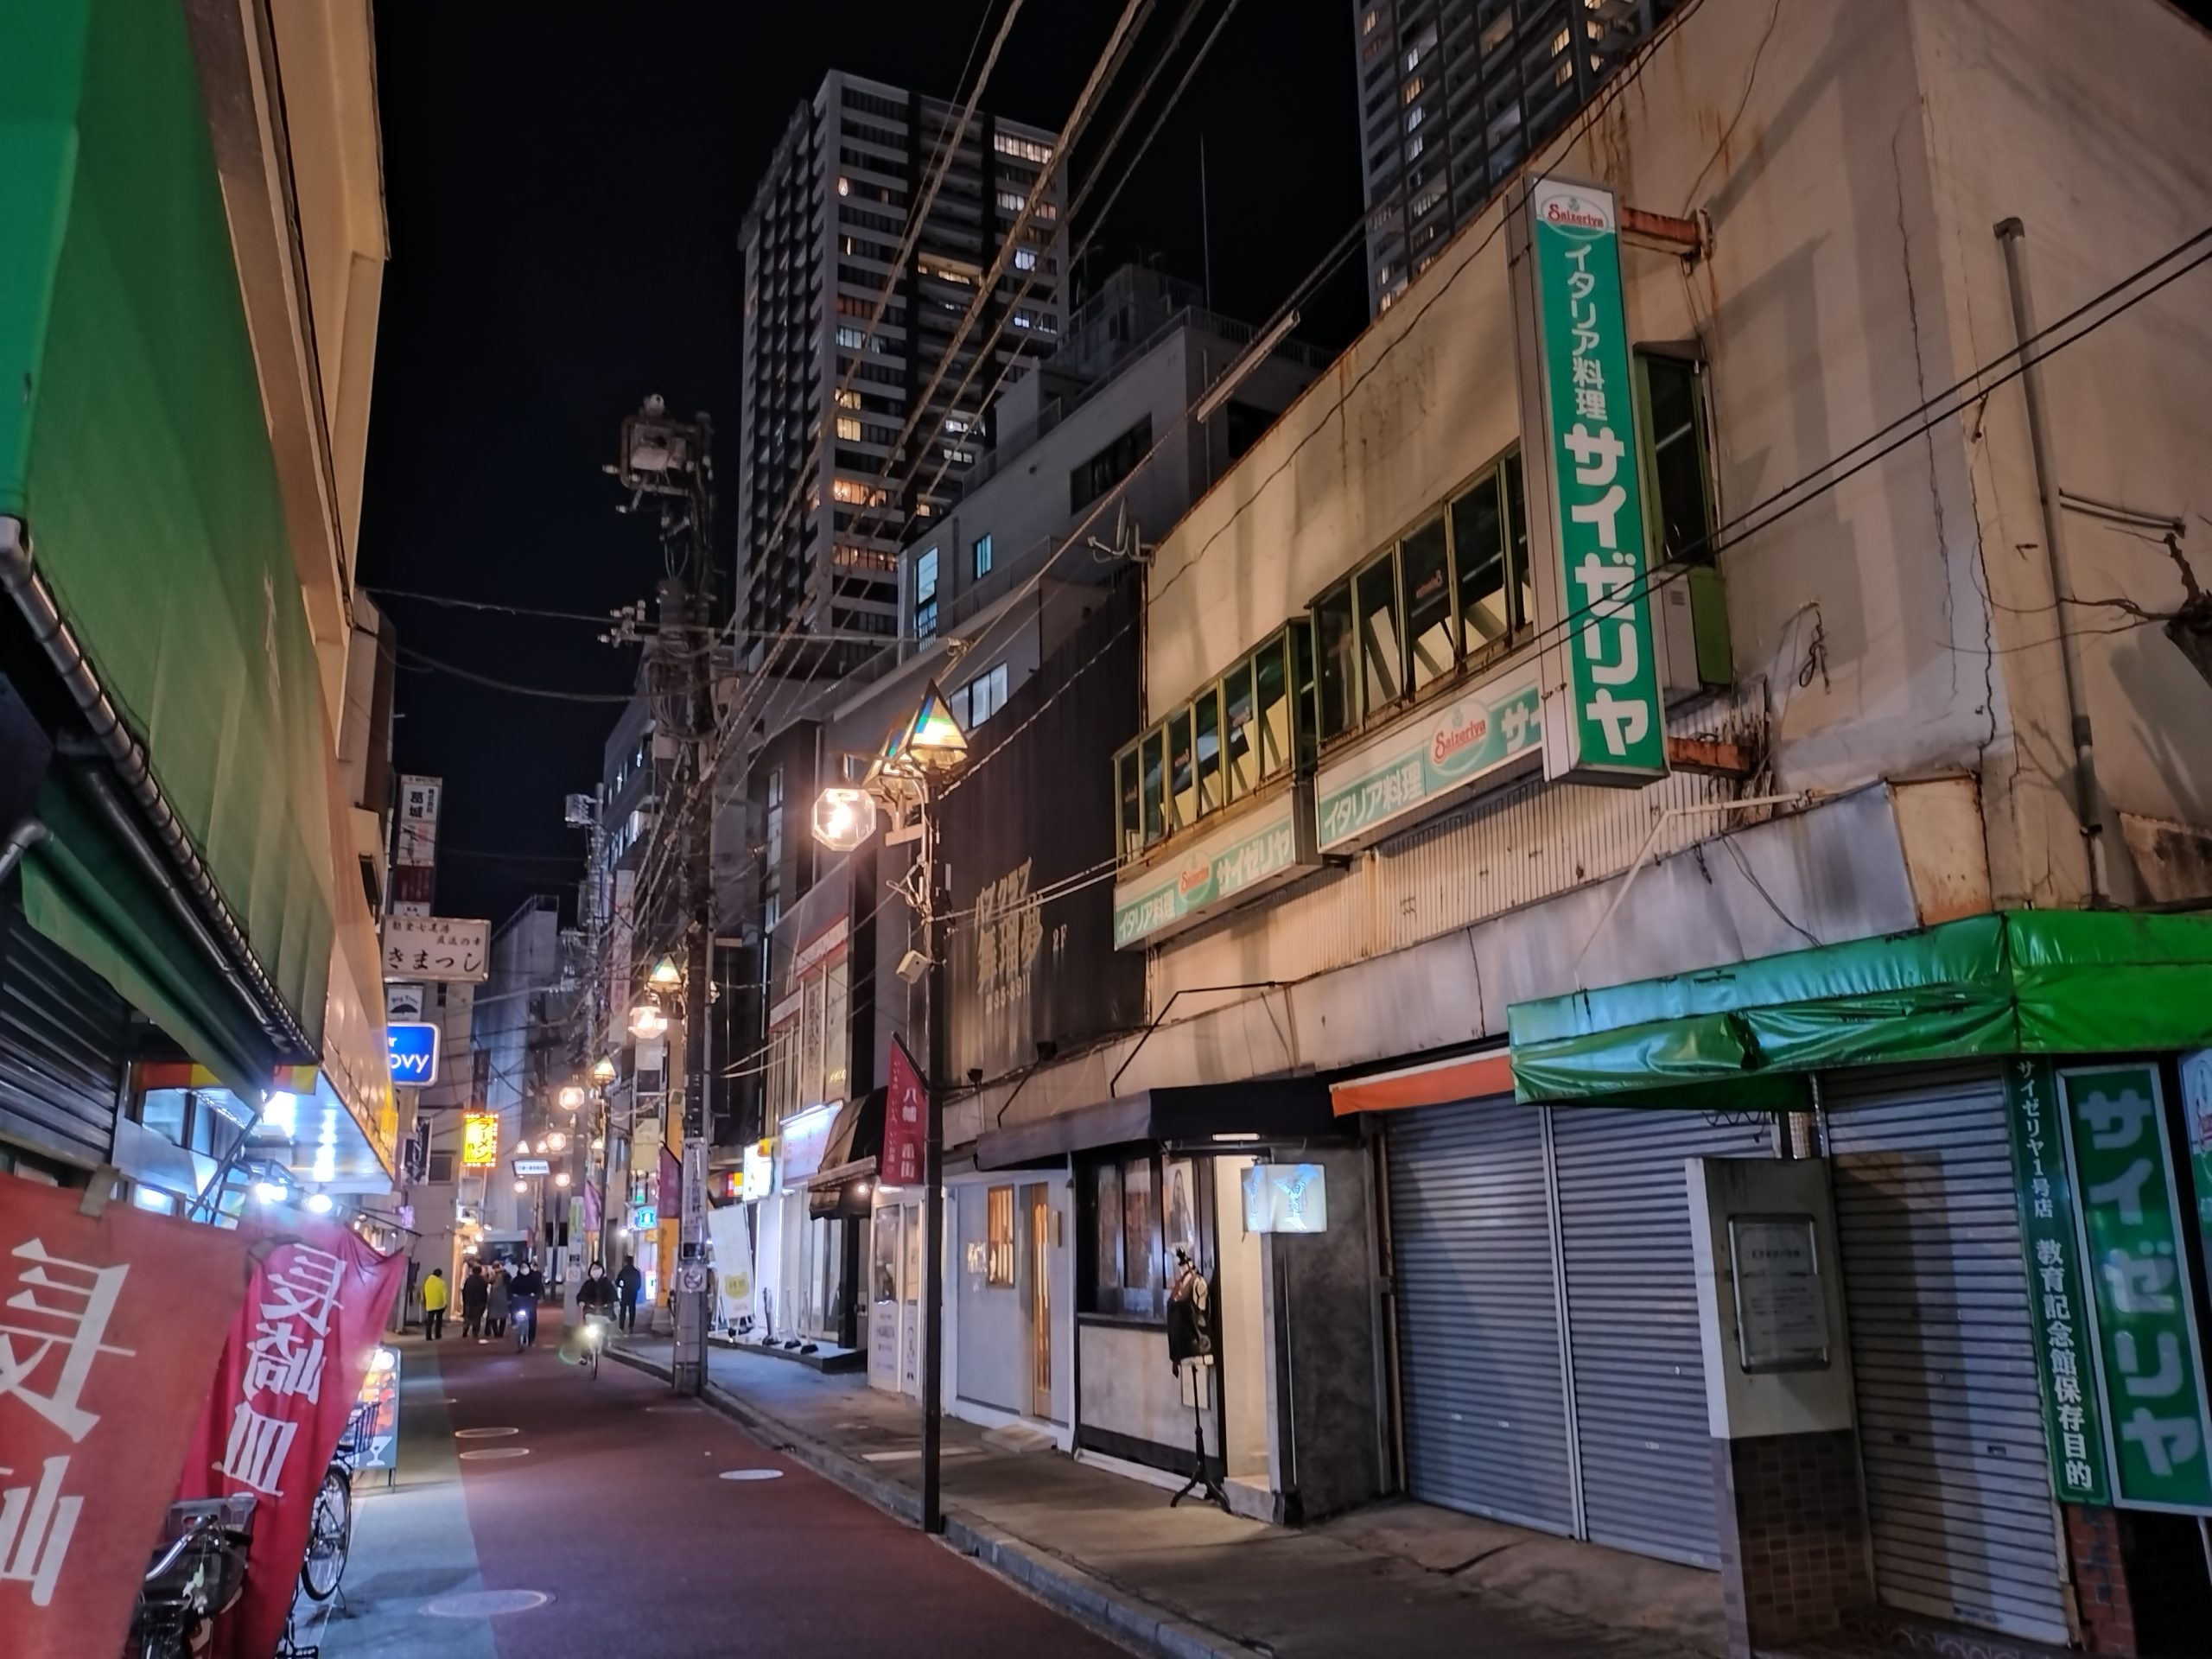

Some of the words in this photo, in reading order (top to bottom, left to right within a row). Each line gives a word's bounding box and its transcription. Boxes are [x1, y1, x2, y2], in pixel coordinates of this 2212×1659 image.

[1548, 203, 1604, 227] Saizeriya
[1565, 245, 1608, 422] イタリア料理
[1563, 423, 1649, 756] サイゼリヤ
[1433, 719, 1486, 764] Saizeriya
[1501, 701, 1541, 755] サ
[1325, 760, 1423, 838] イタリア料理
[1217, 829, 1290, 896] サイゼリヤ
[1052, 923, 1068, 953] 2F
[1119, 889, 1176, 939] イタリア料理
[477, 1120, 490, 1160] ラーメン
[2018, 1059, 2053, 1219] サイゼリヤ1号店
[2077, 1088, 2199, 1477] サイゼリヤ
